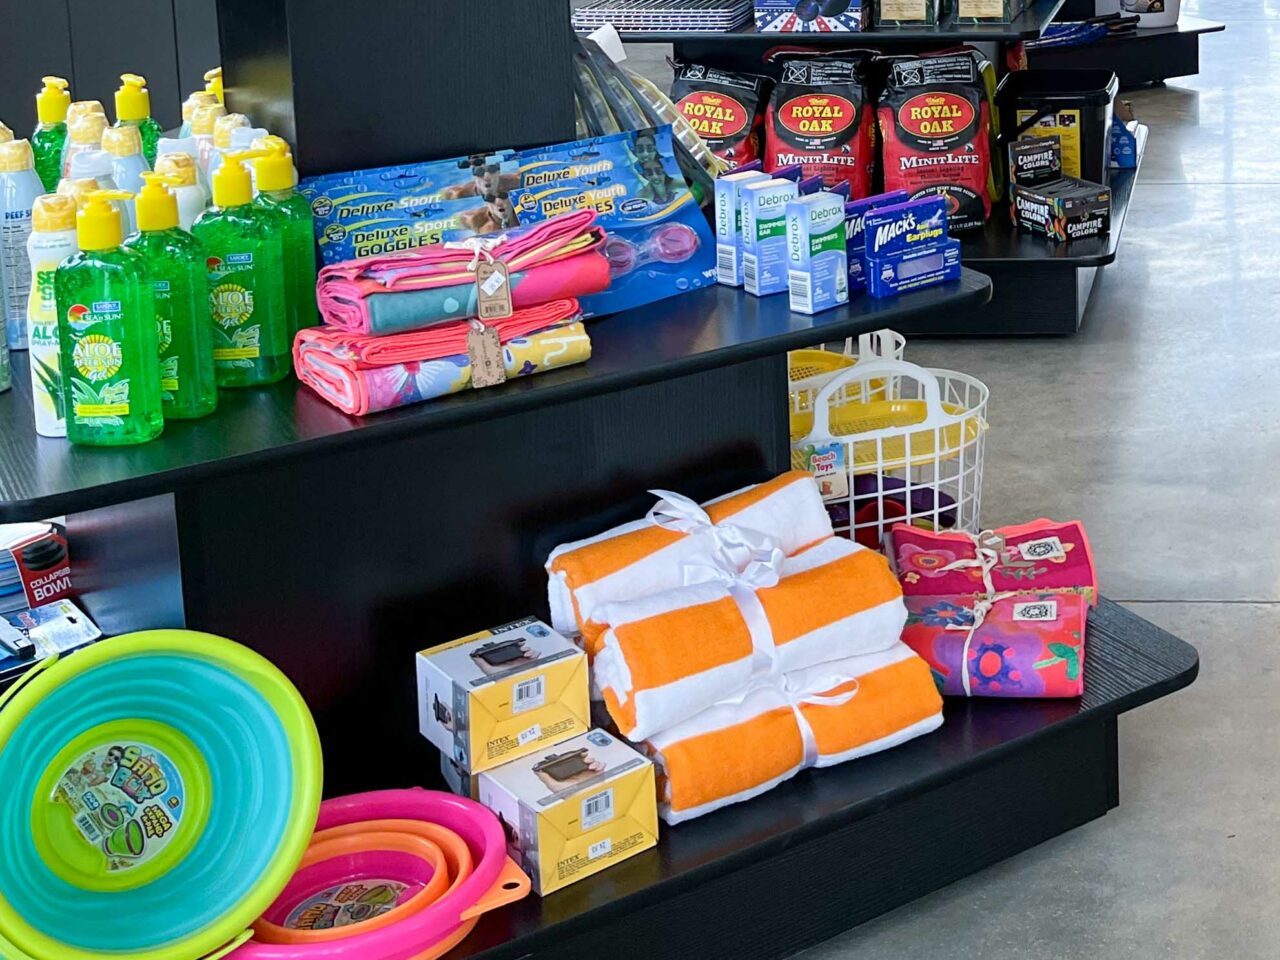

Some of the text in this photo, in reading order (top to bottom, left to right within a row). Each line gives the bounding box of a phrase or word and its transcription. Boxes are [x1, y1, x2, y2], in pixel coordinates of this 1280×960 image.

[683, 101, 735, 122] ROYAL
[791, 106, 843, 118] ROYAL
[911, 105, 962, 120] ROYAL
[689, 118, 724, 135] OAK
[799, 120, 833, 132] OAK
[920, 120, 954, 133] OAK
[1018, 150, 1053, 165] CAMPFIRE
[1023, 160, 1050, 170] COLORS
[526, 160, 613, 186] Deluxe Youth
[543, 184, 626, 212] Deluxe Youth
[758, 192, 795, 207] Debrox
[338, 200, 394, 219] Deluxe
[719, 192, 727, 235] Debrox
[811, 205, 843, 221] Debrox
[1016, 196, 1049, 217] CAMPFIRE
[1021, 209, 1046, 225] COLORS
[354, 217, 457, 244] Deluxe Sport
[1067, 218, 1102, 233] CAMPFIRE
[1072, 227, 1098, 238] COLORS
[790, 216, 800, 262] Debrox
[906, 228, 943, 243] Earplugs
[357, 233, 440, 257] GOGGLES
[210, 290, 253, 305] ALOE
[73, 341, 122, 357] ALOE
[812, 452, 836, 464] Beach
[816, 463, 833, 471] Toys
[493, 618, 533, 635] INTEX
[486, 734, 511, 747] INTEX
[120, 745, 168, 796] SAND
[112, 766, 152, 801] BOX
[151, 805, 172, 830] MEGA
[558, 853, 581, 868] INTEX
